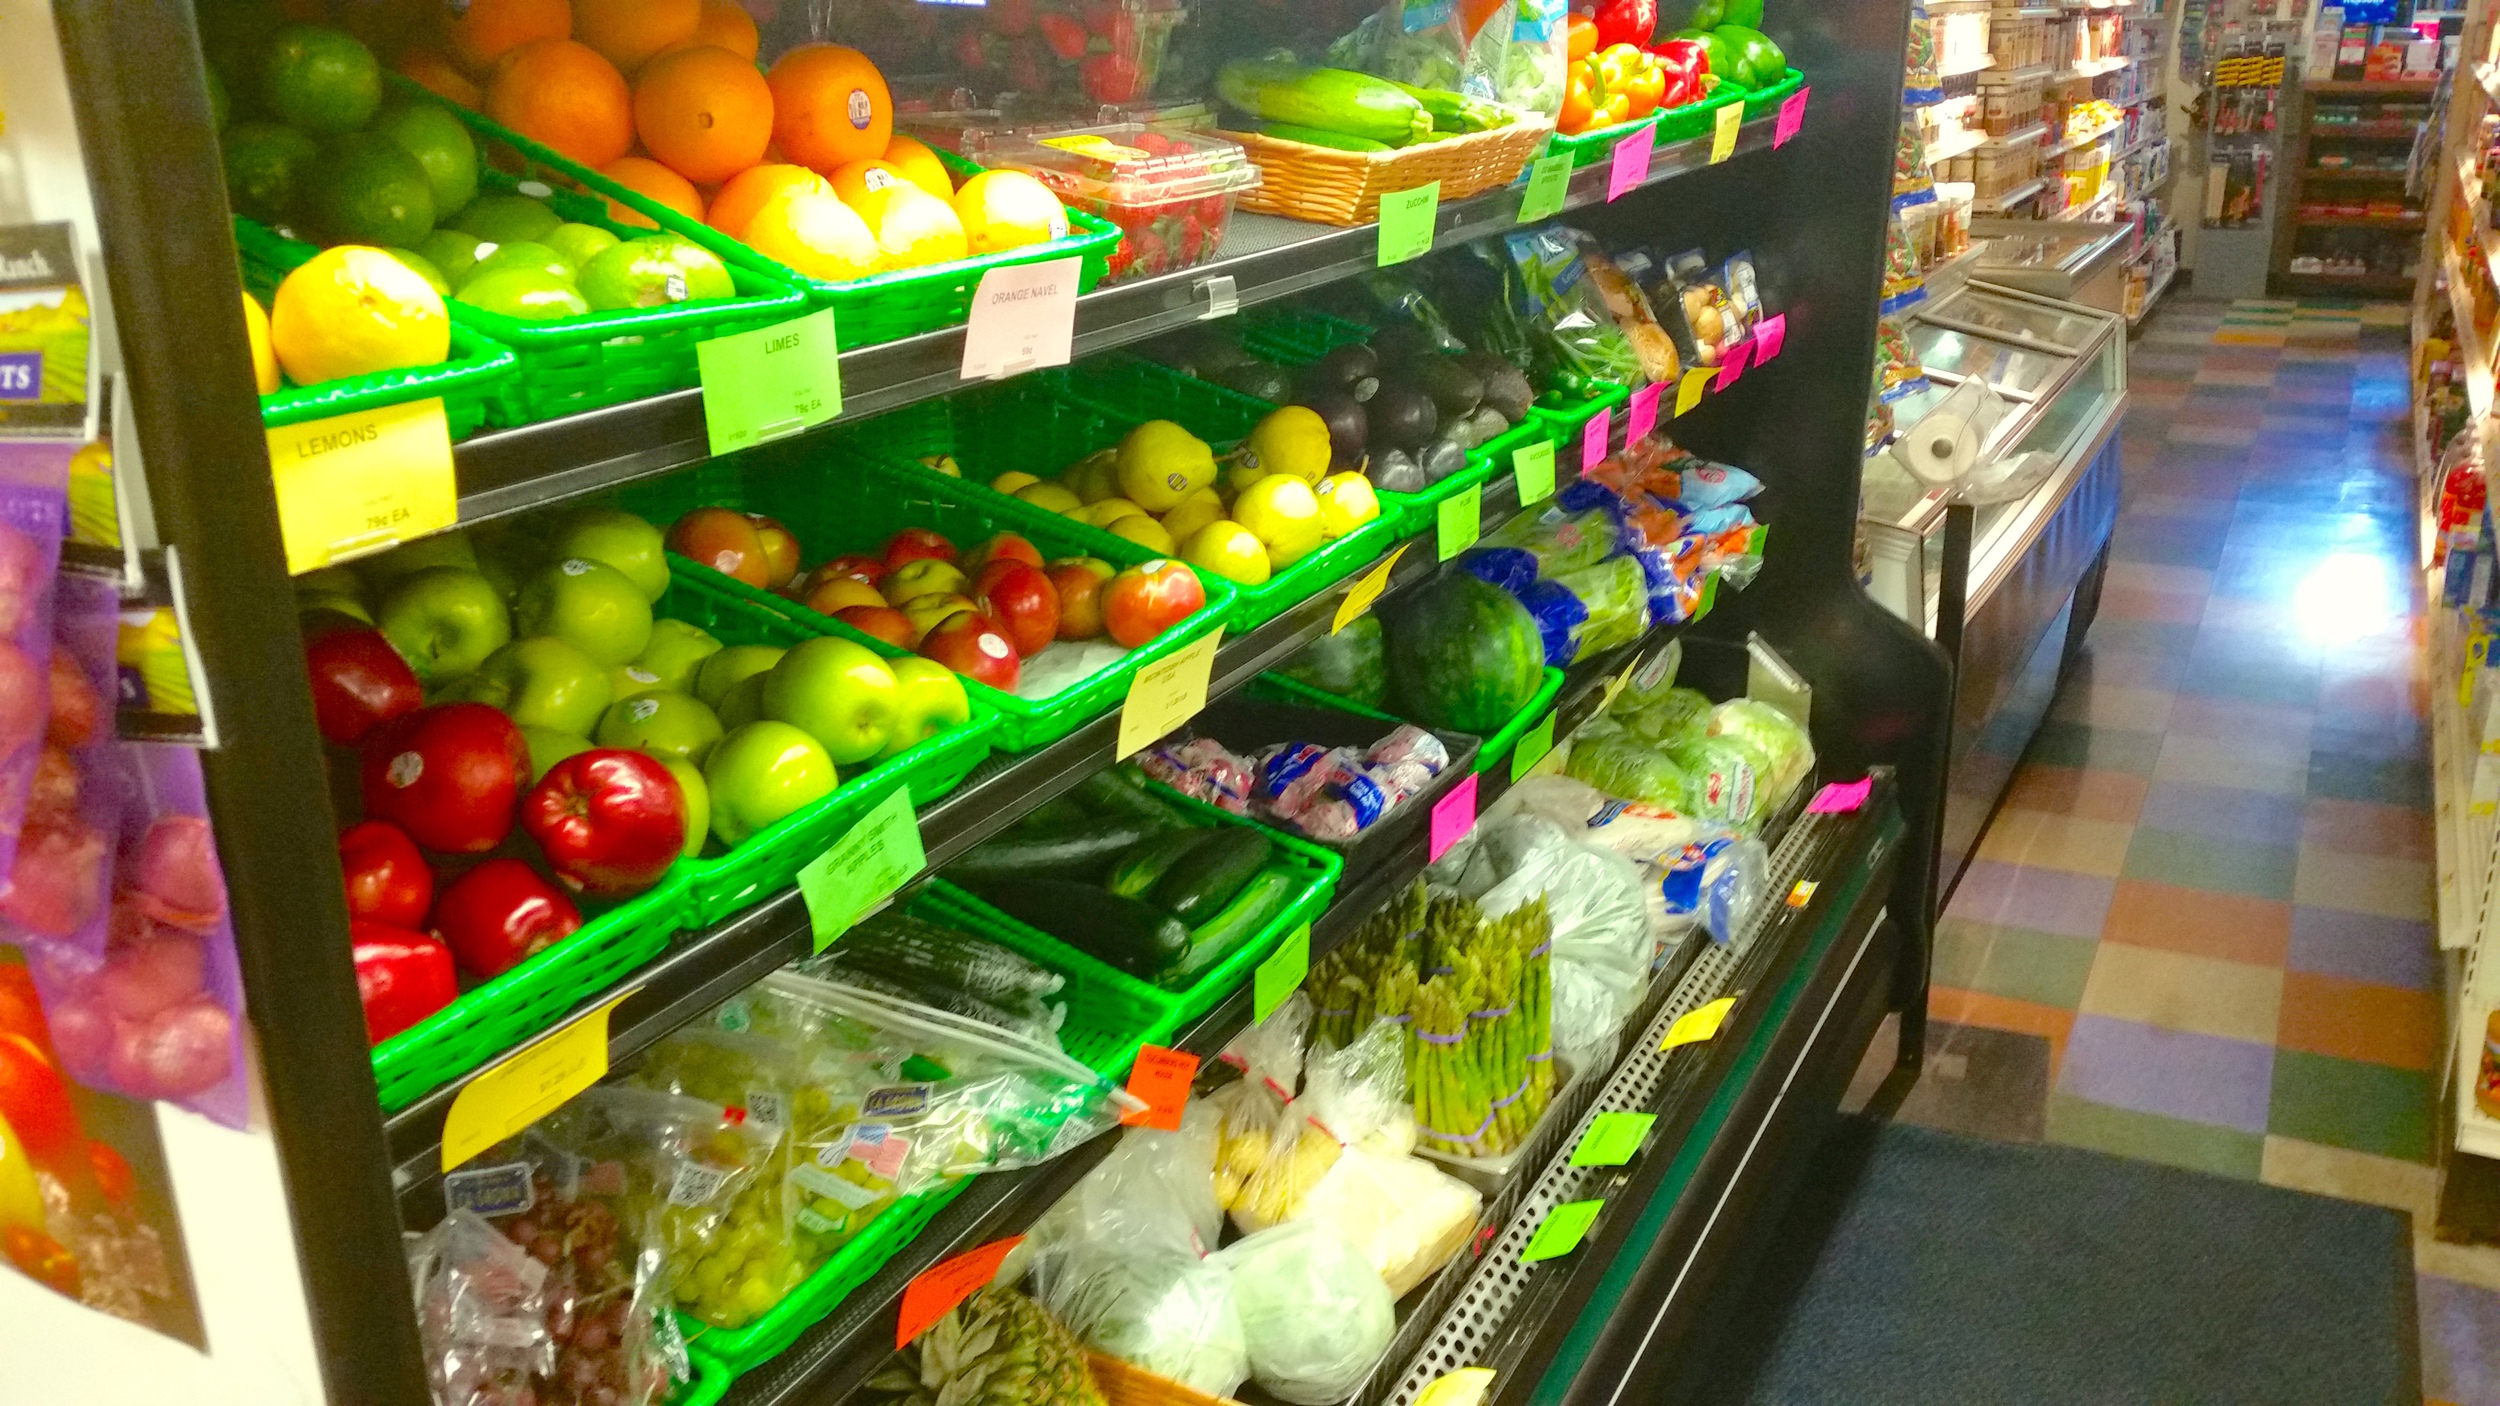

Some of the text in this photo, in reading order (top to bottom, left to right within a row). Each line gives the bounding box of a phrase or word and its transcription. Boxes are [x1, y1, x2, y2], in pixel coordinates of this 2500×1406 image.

[992, 284, 1058, 305] ORANGE NAVEL
[765, 333, 800, 354] LIMES
[296, 424, 378, 458] LEMONS
[392, 507, 410, 522] EA
